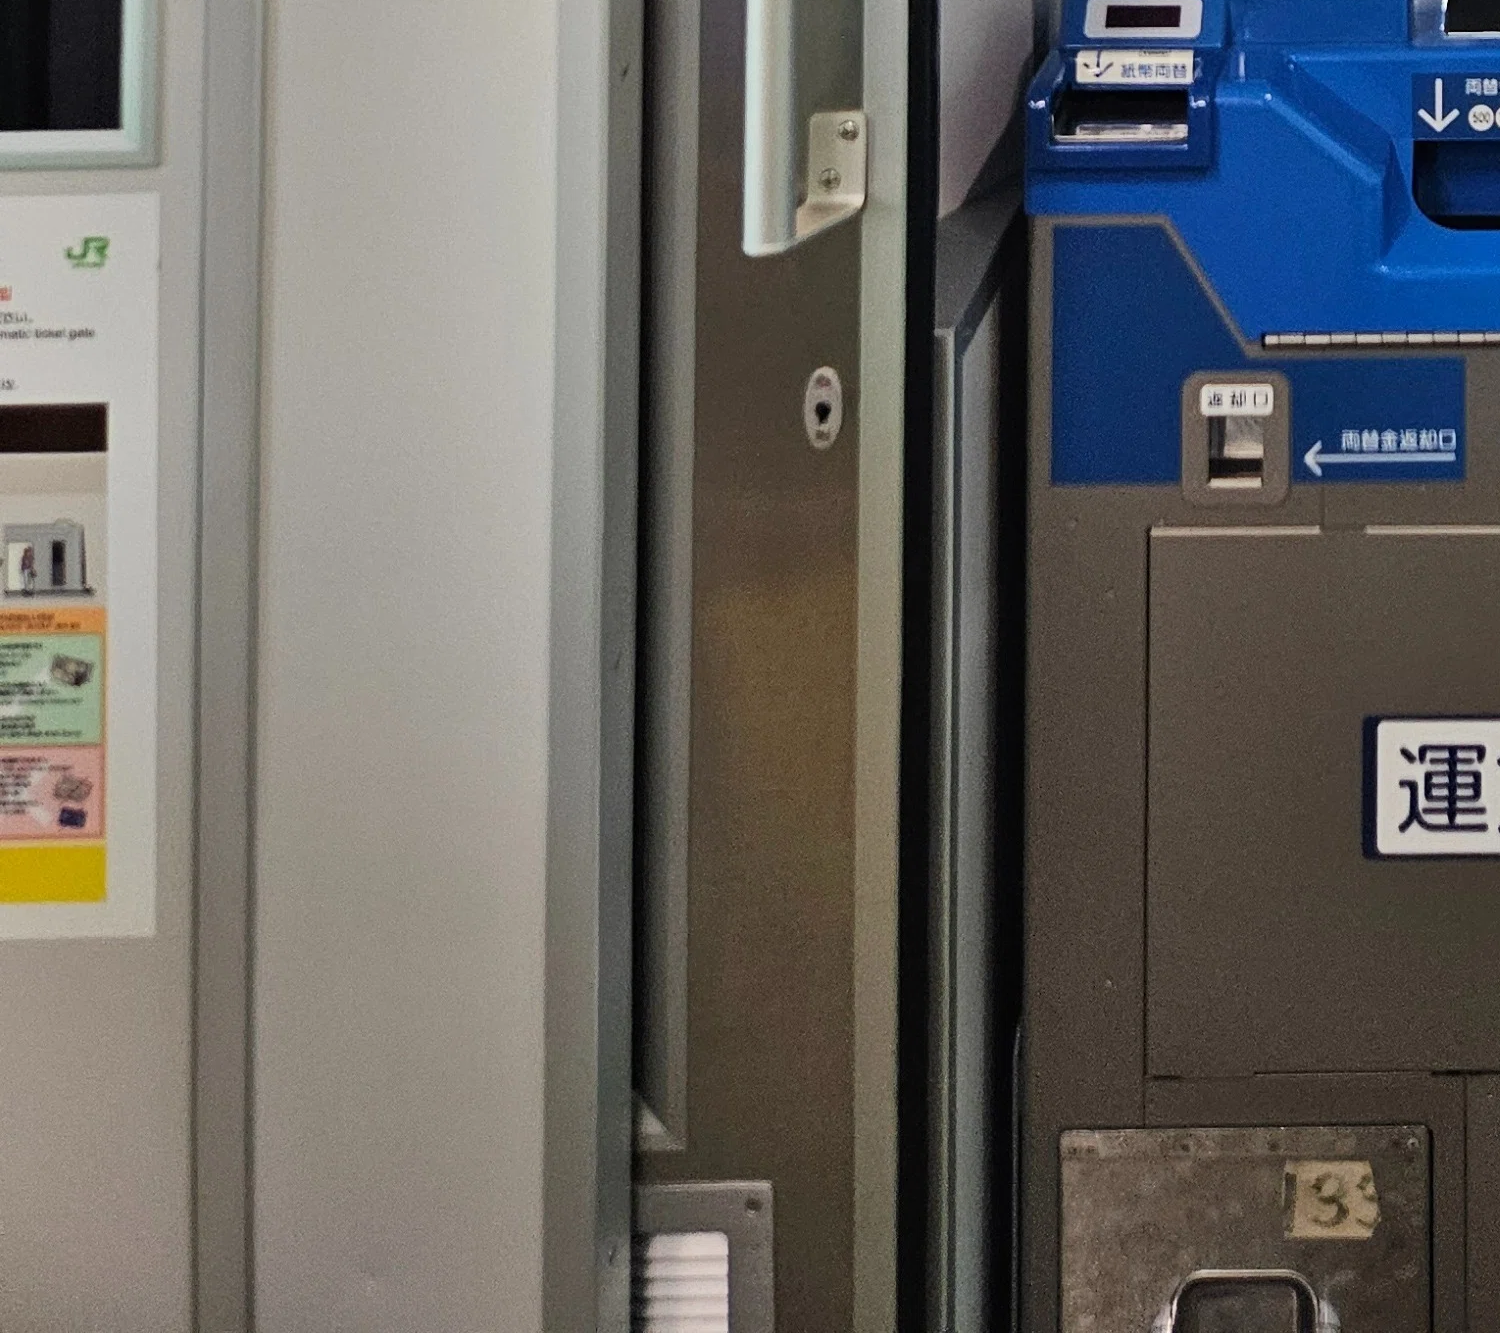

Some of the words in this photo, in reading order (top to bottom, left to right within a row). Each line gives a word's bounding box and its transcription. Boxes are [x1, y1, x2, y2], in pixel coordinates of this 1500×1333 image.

[1207, 390, 1269, 409] 返却口
[1340, 428, 1457, 452] 両替金返却口
